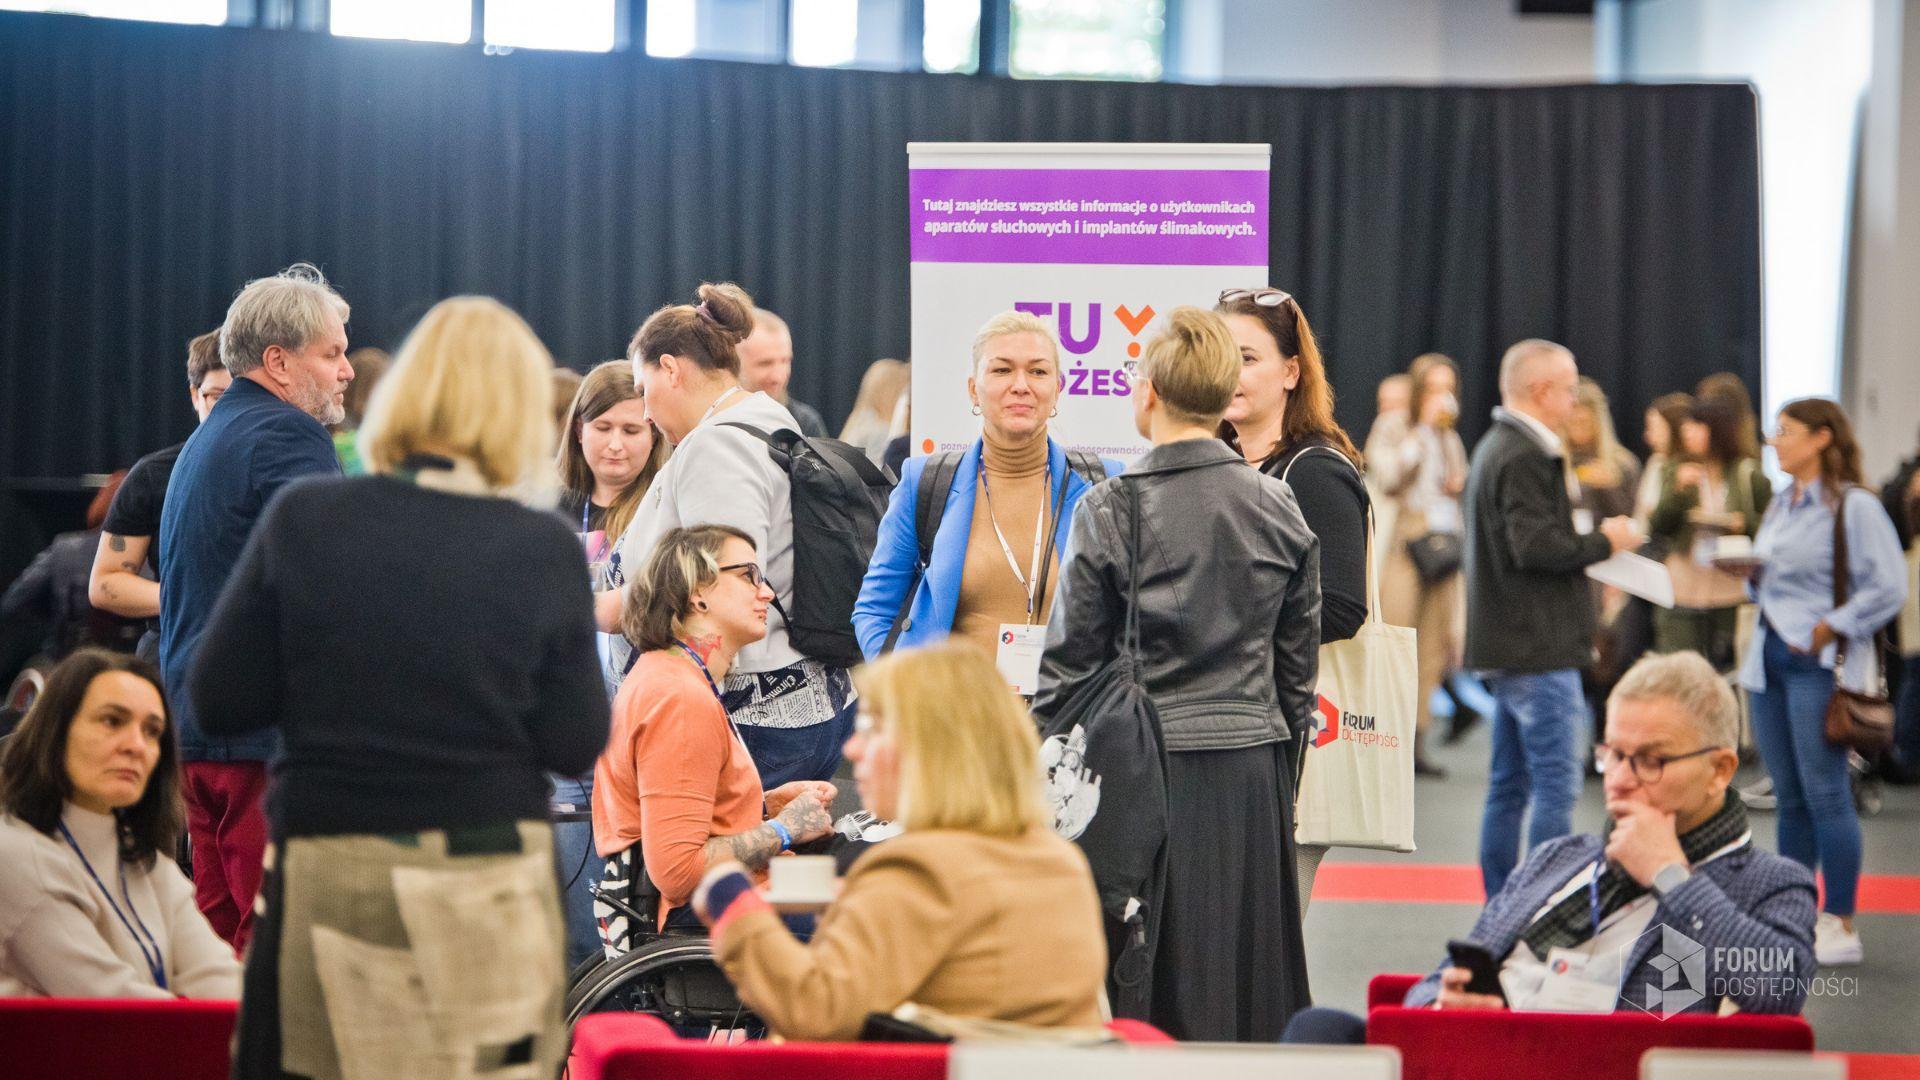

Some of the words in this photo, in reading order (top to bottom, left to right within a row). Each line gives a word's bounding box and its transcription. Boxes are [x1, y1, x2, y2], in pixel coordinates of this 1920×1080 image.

[922, 199, 953, 214] Tutaj
[955, 199, 1017, 215] znajdziesz
[1019, 200, 1078, 215] wszystkie
[1081, 200, 1147, 216] informacje
[1149, 203, 1158, 213] o
[1160, 201, 1256, 216] użytkownikach
[924, 219, 988, 236] aparatów
[990, 220, 1072, 237] słuchowych
[1074, 220, 1080, 234] i
[1082, 220, 1157, 238] implantów
[1160, 221, 1257, 239] ślimakowych.
[1059, 360, 1132, 396] ŻES
[941, 443, 972, 452] pozna
[1343, 711, 1375, 731] FORUM
